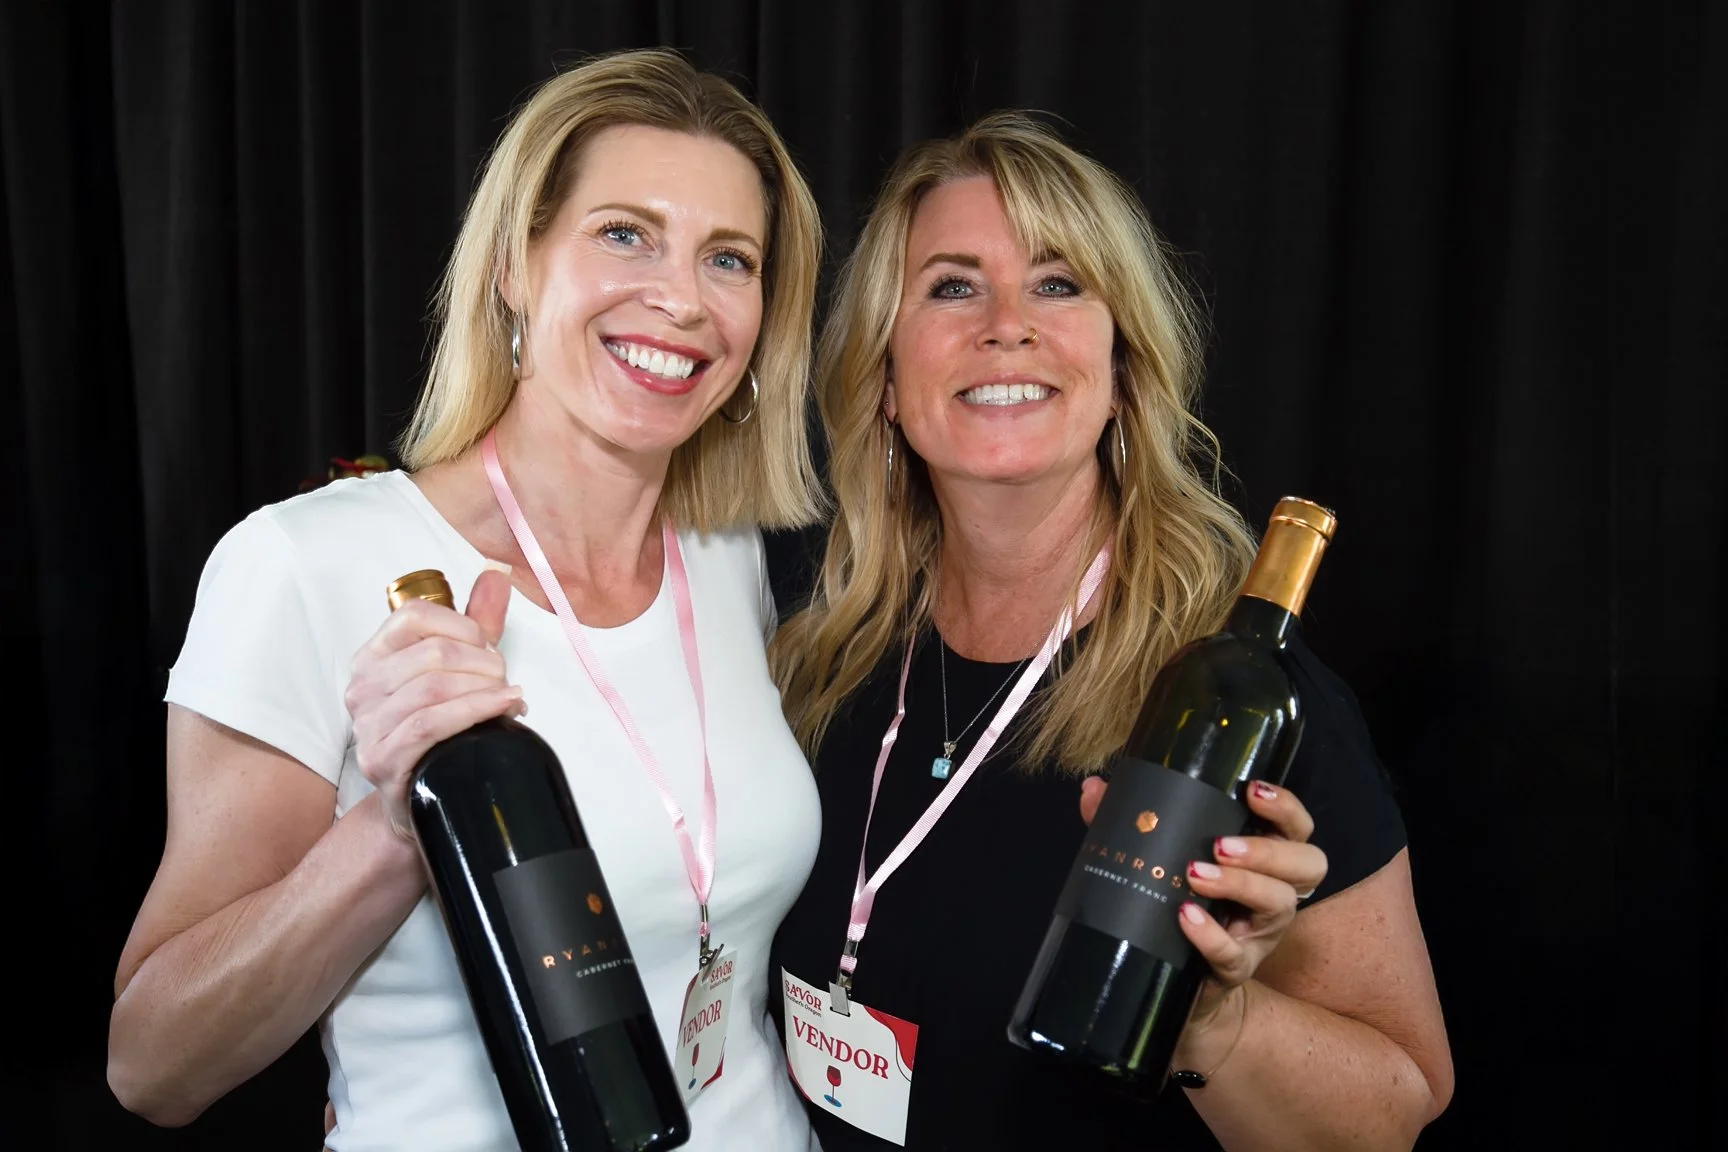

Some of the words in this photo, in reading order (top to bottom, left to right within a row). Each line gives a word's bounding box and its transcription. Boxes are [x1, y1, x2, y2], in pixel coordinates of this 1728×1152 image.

[1083, 864, 1129, 885] CABERNET
[1132, 881, 1168, 903] FRANC
[1085, 843, 1196, 897] YANROS
[542, 939, 612, 968] RYAN
[576, 960, 622, 978] CABERNET
[710, 960, 733, 983] SAVOR
[785, 979, 822, 1011] SAVOR
[682, 999, 722, 1048] VENDOR
[792, 1015, 889, 1080] VENDOR
